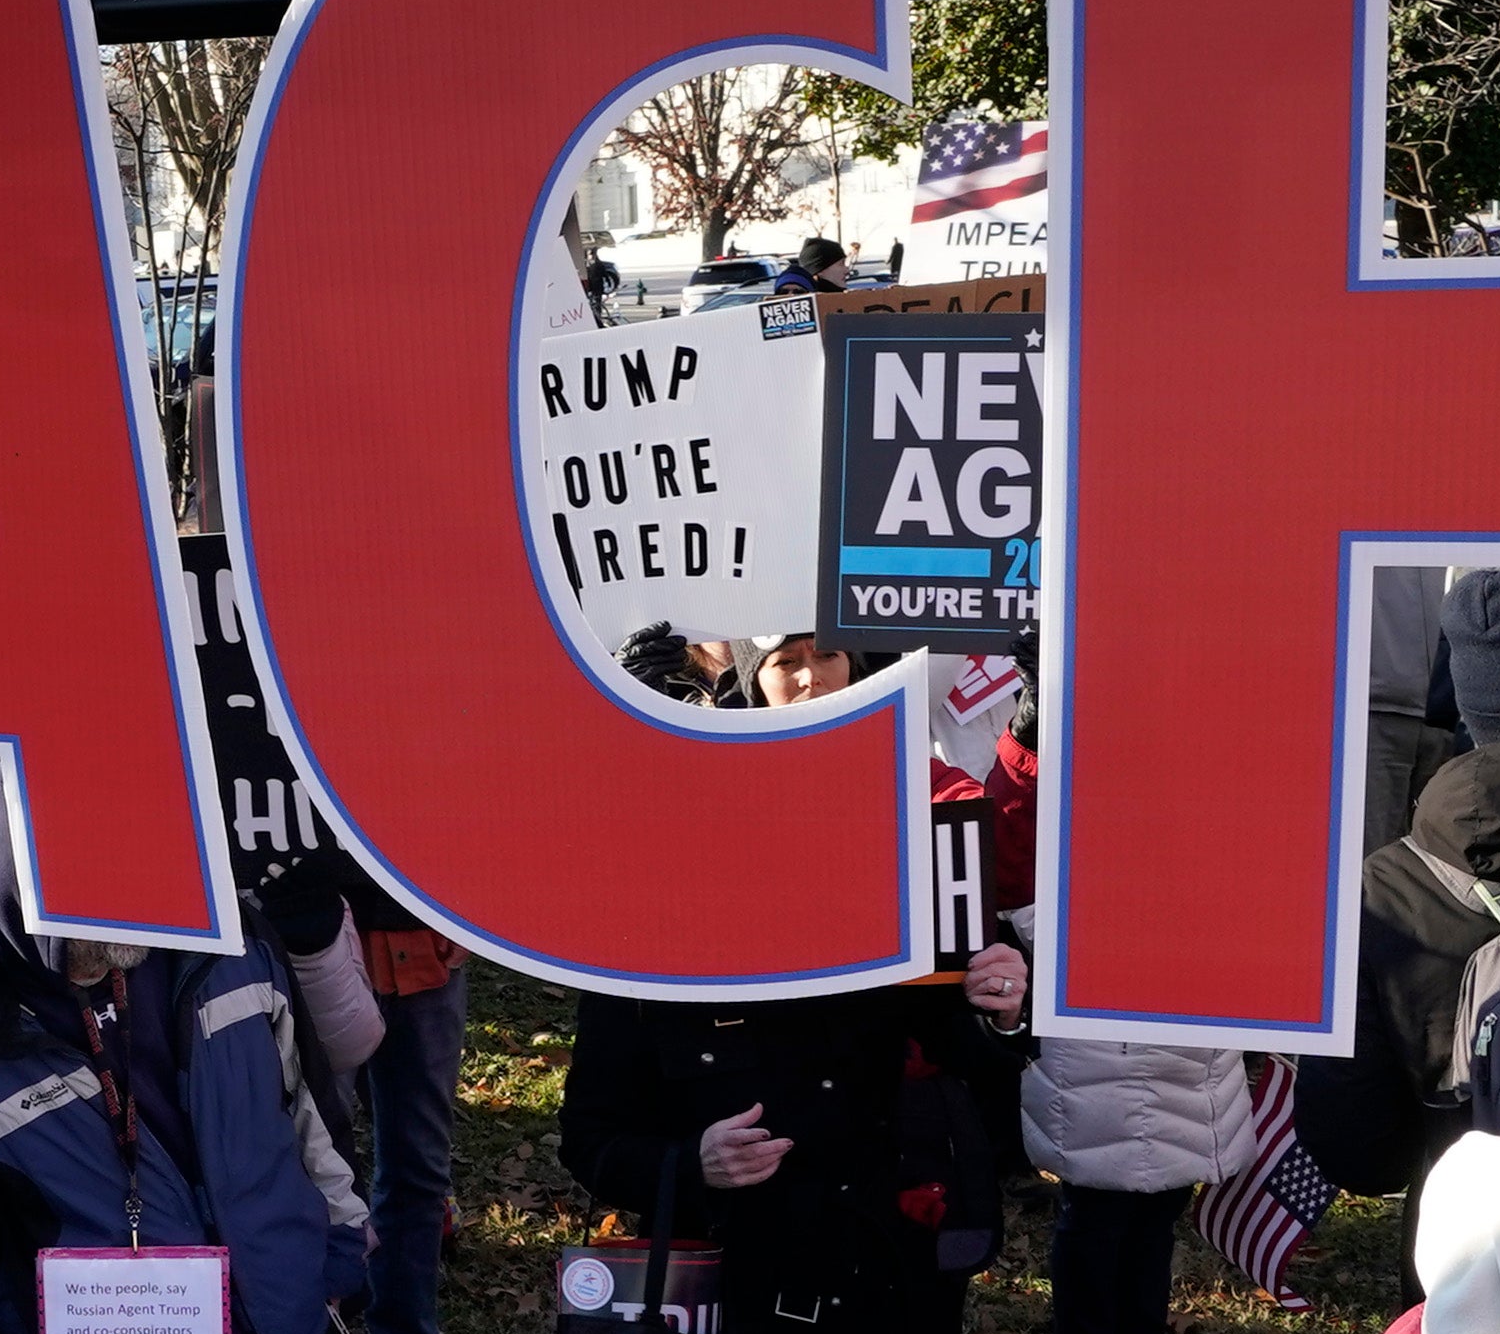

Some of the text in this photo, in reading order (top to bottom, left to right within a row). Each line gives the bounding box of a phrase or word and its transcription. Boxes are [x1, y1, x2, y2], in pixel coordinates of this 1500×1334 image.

[947, 222, 1047, 246] IMPEA
[762, 300, 811, 318] NEVER
[766, 311, 811, 329] AGAIN
[541, 345, 698, 419] RUMP
[545, 438, 718, 509] OU'RE
[850, 585, 983, 619] YOU'RE
[65, 1283, 188, 1298] We the people, say
[66, 1304, 201, 1317] Russian Agent Trump
